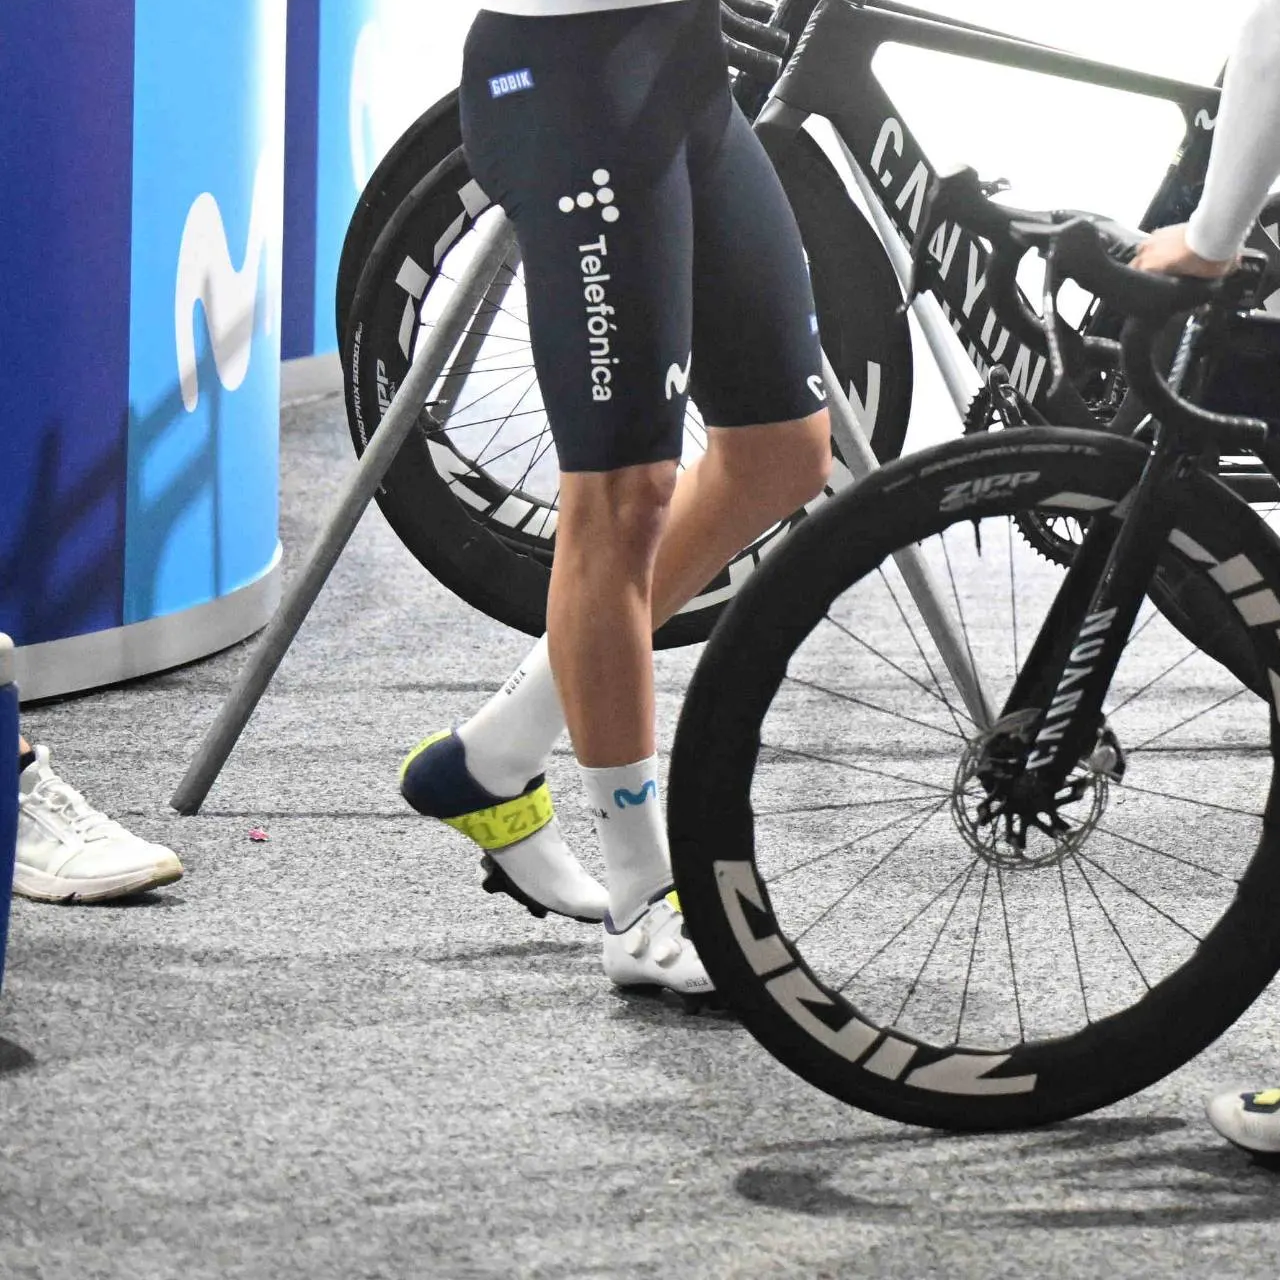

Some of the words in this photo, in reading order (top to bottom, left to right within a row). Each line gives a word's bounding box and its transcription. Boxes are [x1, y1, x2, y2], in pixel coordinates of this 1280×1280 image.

[490, 70, 531, 97] GOBIK
[578, 233, 617, 401] Telefónica
[1026, 606, 1117, 770] CANYON
[714, 859, 1038, 1095] ZIPP
